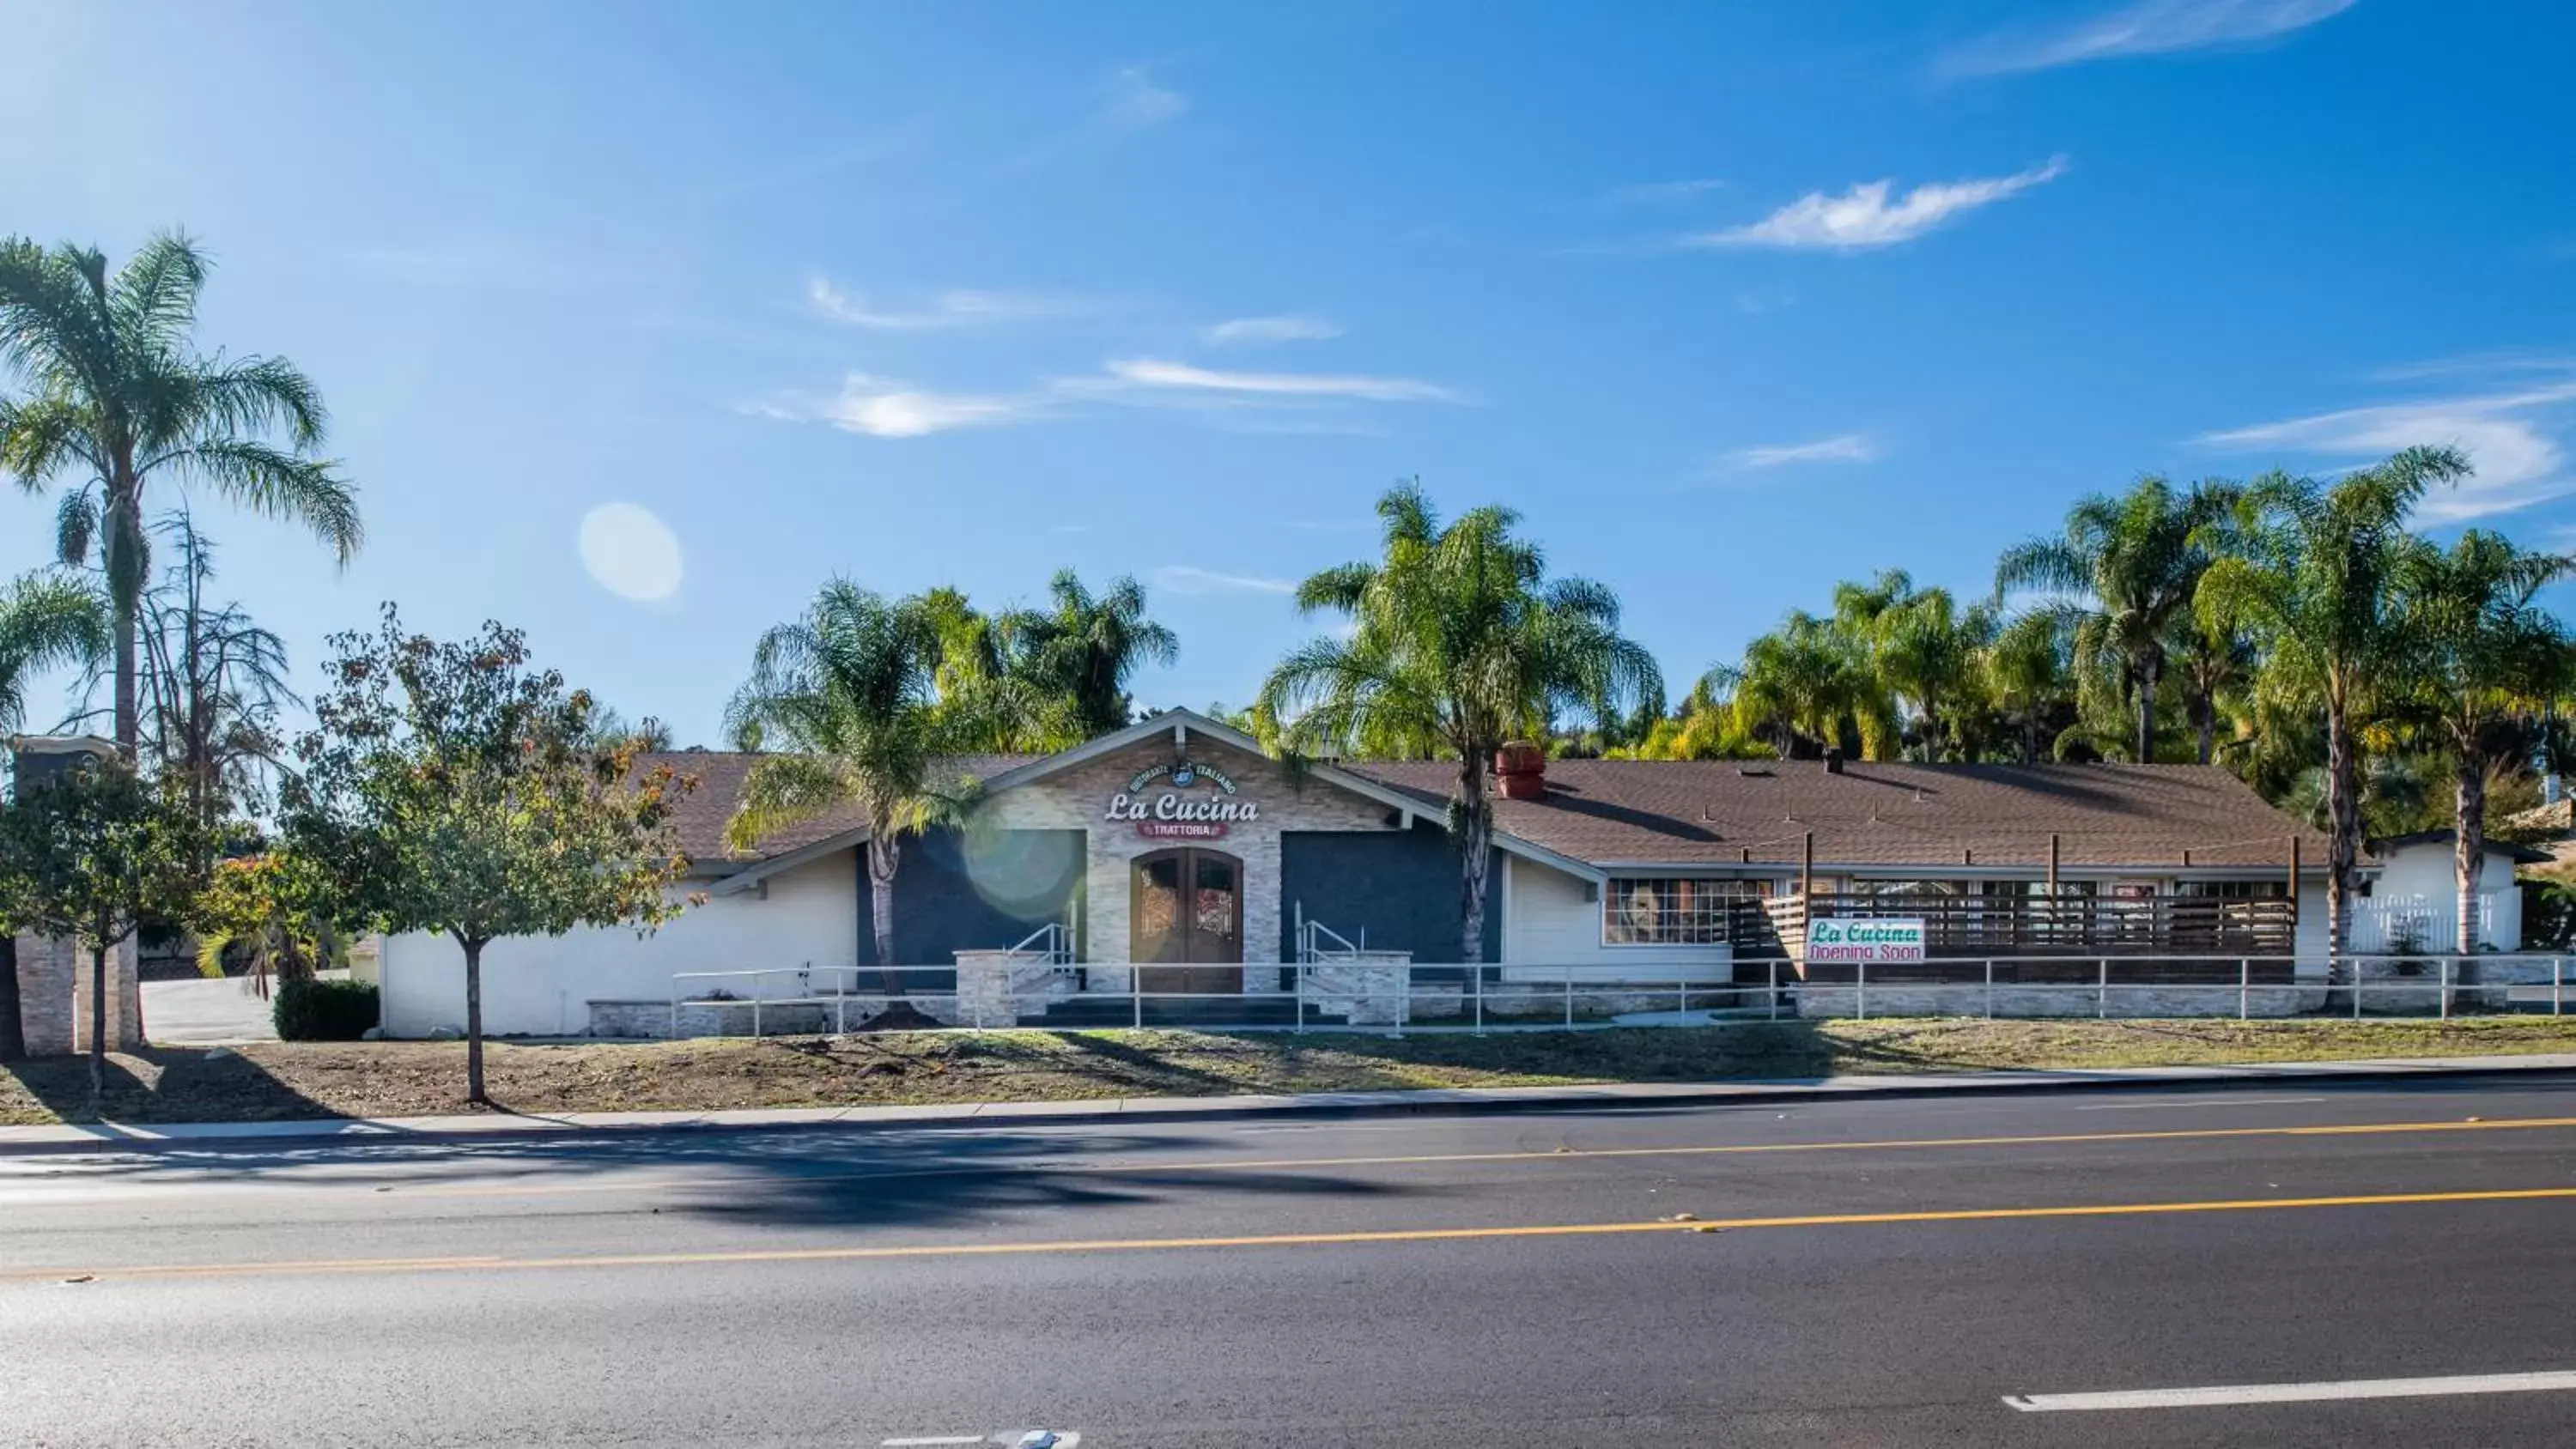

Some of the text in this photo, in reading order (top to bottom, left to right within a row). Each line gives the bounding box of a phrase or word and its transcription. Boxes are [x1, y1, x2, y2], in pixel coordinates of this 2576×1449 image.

[1196, 765, 1236, 794] ITALIANO
[1104, 793, 1260, 822] La Cucina
[1154, 825, 1210, 835] TRATTORIA
[1811, 921, 1919, 943] La Cucina
[1809, 943, 1922, 961] Opening Soon
